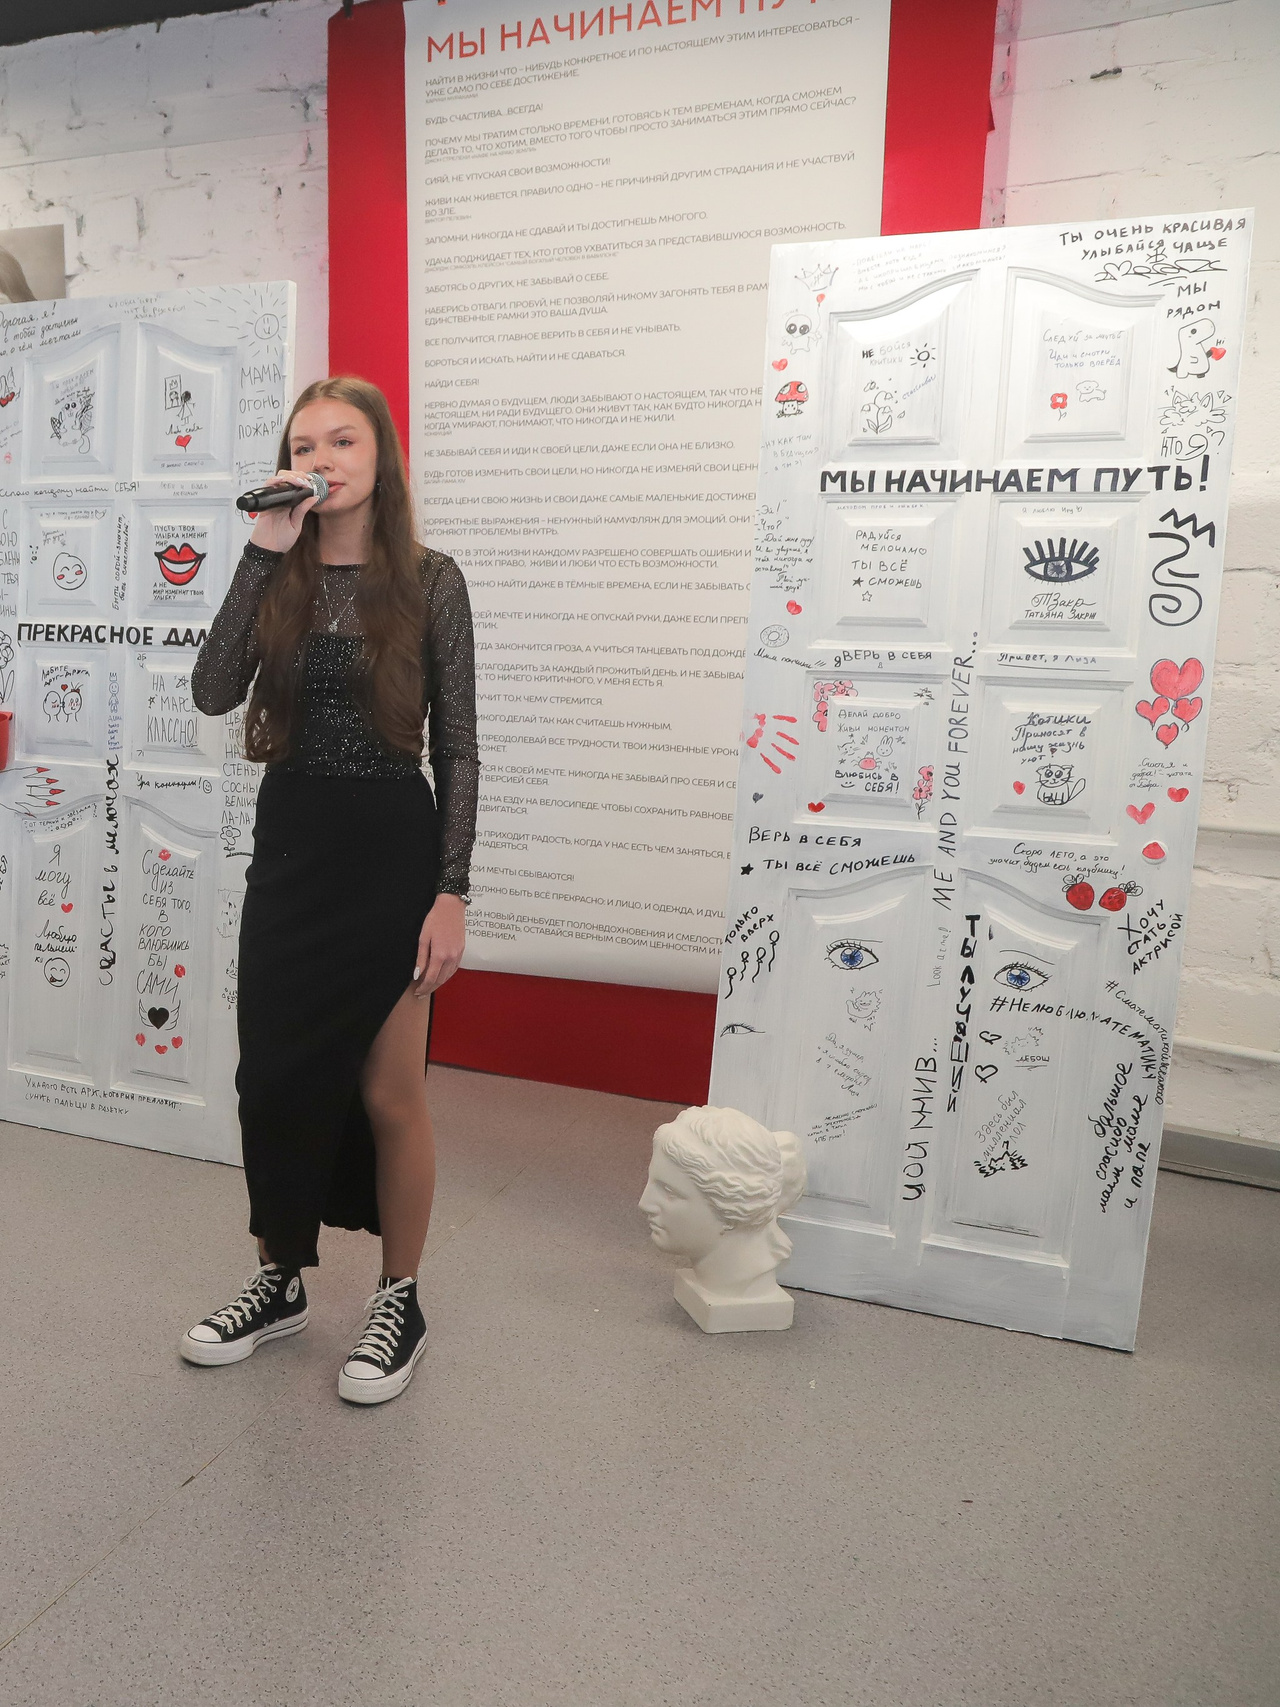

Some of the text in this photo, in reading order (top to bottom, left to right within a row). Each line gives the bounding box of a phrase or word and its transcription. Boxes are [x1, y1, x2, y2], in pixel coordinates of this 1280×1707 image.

[427, 0, 721, 62] МЫ НАЧИНАЕМ
[426, 76, 455, 85] НАЙТИ
[466, 70, 498, 80] ЖИЗНИ
[525, 61, 562, 71] НИБУДЬ
[564, 50, 626, 65] КОНКРЕТНОЕ
[654, 36, 724, 51] НАСТОЯЩЕМУ
[727, 31, 756, 41] ЭТИМ
[758, 17, 853, 36] ИНТЕРЕСОВАТЬСЯ
[1060, 218, 1246, 246] ТЫ ОЧЕНЬ КРАСИВАЯ
[424, 257, 451, 268] УДАЧА
[454, 252, 511, 265] ПОДЖИДАЕТ
[533, 249, 550, 259] КТО
[553, 246, 581, 256] ГОТОВ
[584, 241, 642, 254] УХВАТИТЬСЯ
[659, 230, 761, 244] ПРЕДСТАВИВШУЮСЯ
[1081, 238, 1228, 260] УЛЫБАЙСЯ ЧАЩЕ
[1177, 282, 1207, 298] МЫ
[1166, 301, 1220, 319] РЯДОМ
[425, 338, 439, 346] ВСЕ
[498, 332, 538, 341] ГЛАВНОЕ
[541, 330, 576, 338] ВЕРИТЬ
[586, 328, 609, 336] СЕБЯ
[862, 349, 874, 359] НЕ
[425, 379, 452, 387] НАЙДИ
[240, 394, 280, 414] ОГОНЬ
[436, 447, 476, 456] ЗАБЫВАЙ
[540, 444, 570, 453] СВОЕЙ
[601, 444, 629, 452] ДАЖЕ
[778, 436, 794, 446] КАК
[1161, 436, 1182, 458] КТО
[820, 454, 1210, 493] МЫ НАЧИНАЕМ ПУТЬ!
[114, 482, 140, 492] СЕБЯ!
[856, 528, 902, 542] РАДУЙСЯ
[861, 544, 919, 554] МЕЛОЧАМ
[852, 559, 908, 572] ТЫ ВСЁ
[2, 572, 18, 586] ТЕБЯ
[868, 577, 922, 588] СМОЖЕШЬ
[1024, 610, 1064, 619] ТАТЬЯНА
[18, 623, 154, 646] ПРЕКРАСНОЕ
[842, 650, 932, 662] ВЕРЬ В СЕБЯ
[152, 674, 166, 692] НА
[160, 696, 197, 712] МАРСЕ
[1026, 712, 1091, 726] Котики
[147, 714, 198, 744] КЛАССНО!
[222, 780, 258, 794] СОСНЫ
[865, 782, 900, 794] СЕБЯ!
[749, 826, 862, 847] ВЕРЬ В СЕБЯ
[932, 762, 960, 910] ME AND YOU
[49, 845, 61, 866] Я
[763, 854, 915, 875] ТЫ ВСЁ СМОЖЕШЬ
[36, 870, 72, 898] могу
[38, 890, 55, 906] всё
[142, 894, 167, 908] СЕБЯ
[158, 910, 168, 922] В
[724, 906, 758, 944] ТОЛЬКО
[1117, 899, 1164, 940] ХОЧУ
[139, 926, 171, 938] КОГО
[741, 914, 774, 942] ВВЕРХ
[1128, 922, 1166, 955] СТАТЬ
[1133, 912, 1184, 974] АКТРИСОЙ
[148, 954, 168, 968] БЫ
[137, 970, 180, 1004] САМИ
[1001, 1090, 1018, 1111] был
[1011, 1121, 1026, 1144] лол
